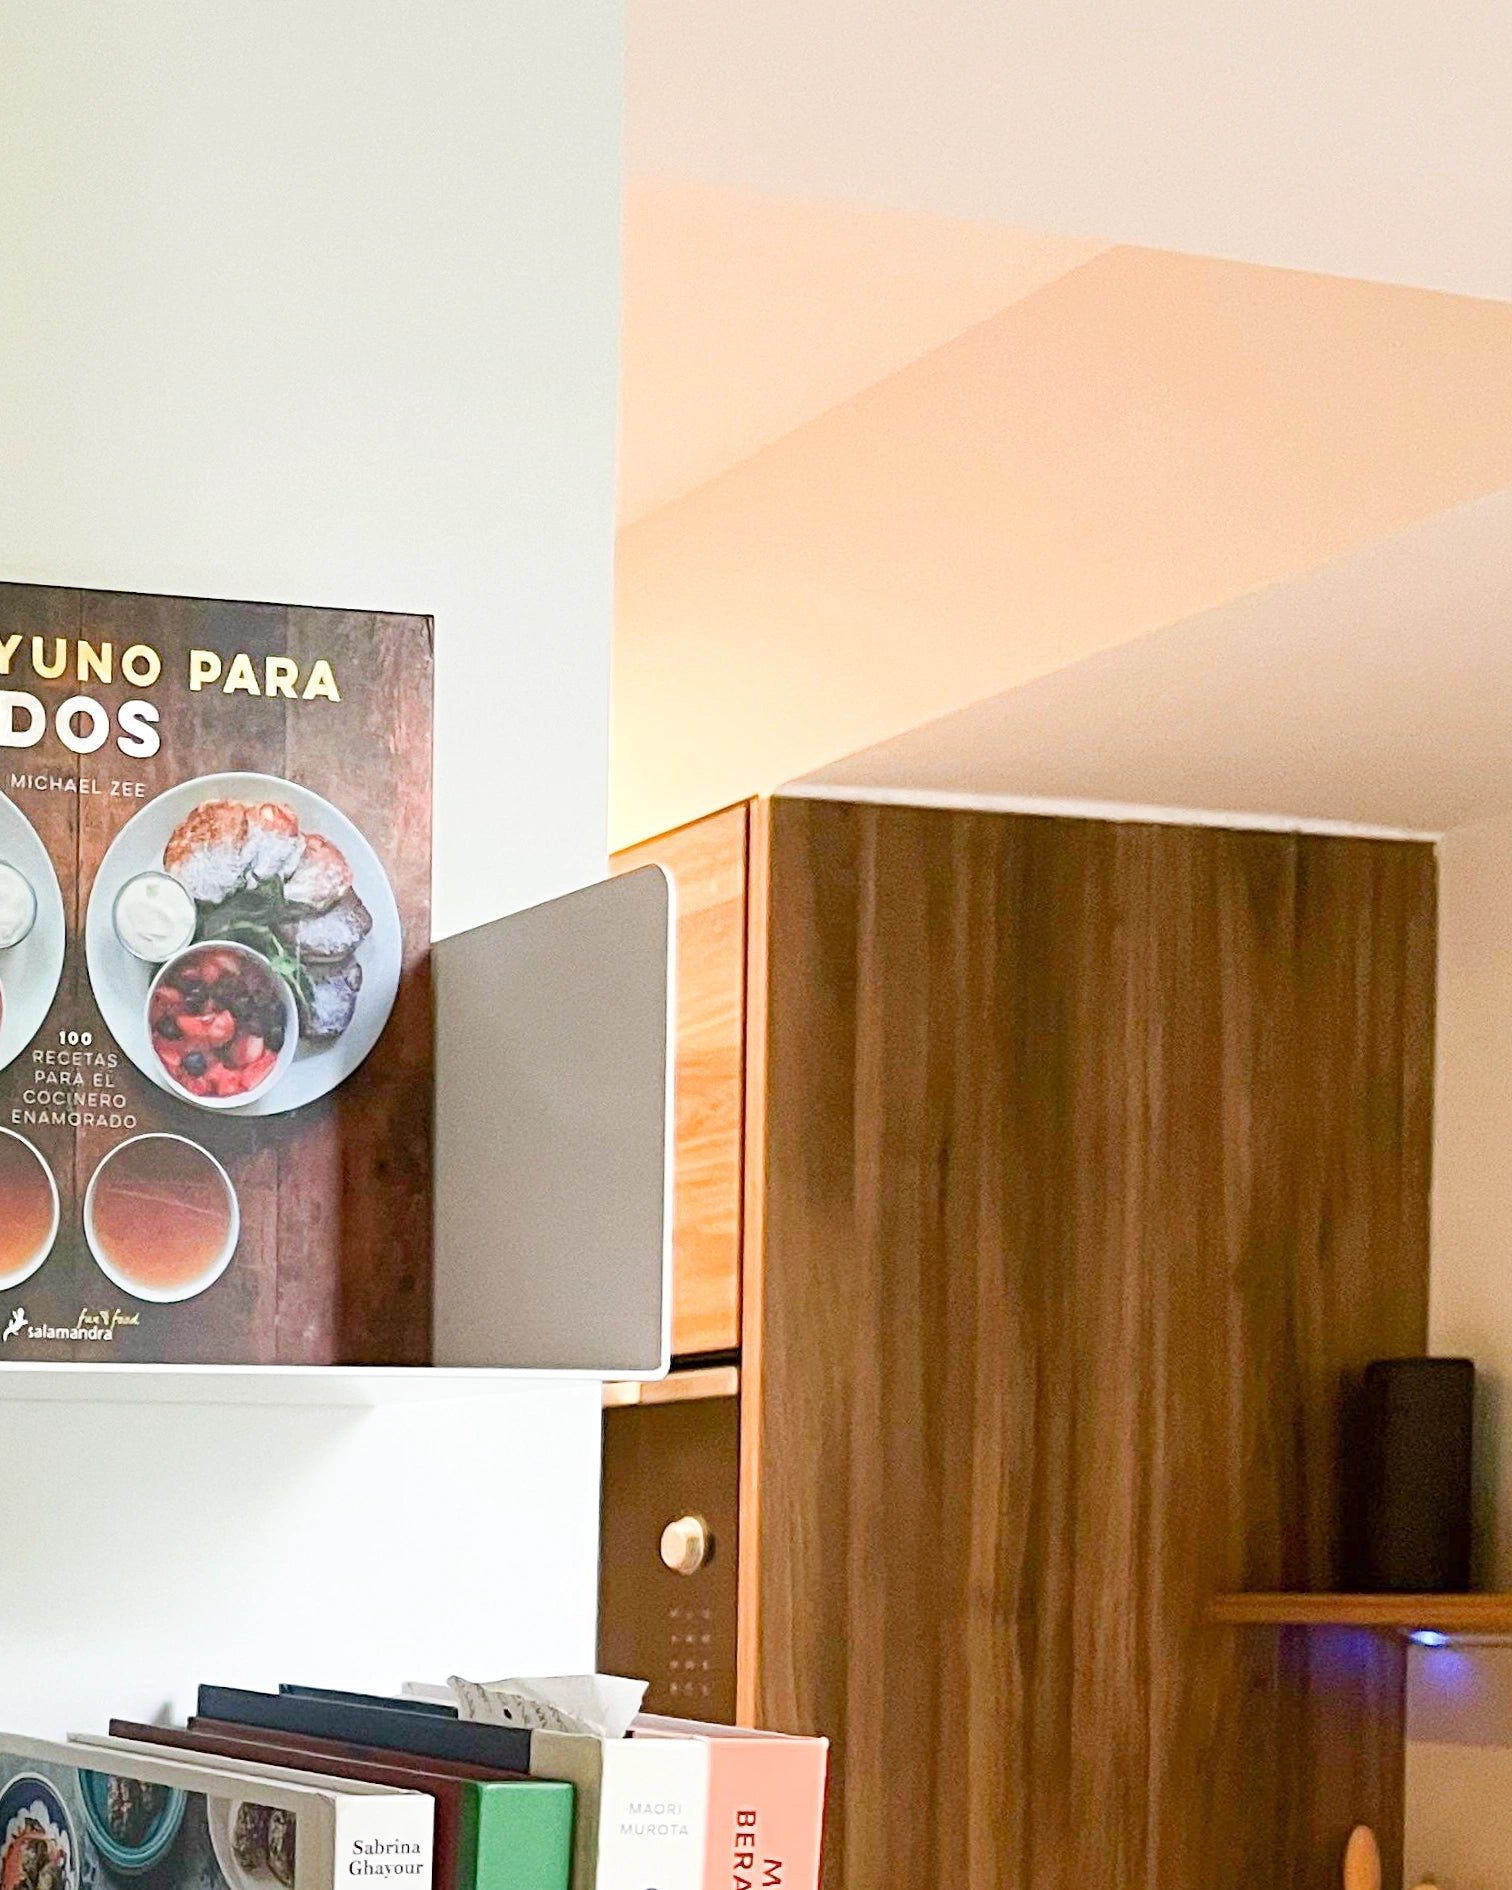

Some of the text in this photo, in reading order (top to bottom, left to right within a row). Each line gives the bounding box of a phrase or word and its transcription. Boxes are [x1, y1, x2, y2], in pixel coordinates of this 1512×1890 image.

[190, 650, 340, 701] PARA
[10, 773, 146, 798] MICHAEL ZEE
[58, 1030, 92, 1046] 100
[33, 1050, 118, 1069] RECETAS
[35, 1070, 115, 1088] PARA EL
[23, 1089, 127, 1110] COCINERO
[11, 1109, 137, 1129] ENAMORADO
[27, 1323, 113, 1341] salamandra
[629, 1803, 682, 1816] MAORI
[620, 1823, 689, 1837] MUROTA
[352, 1839, 421, 1856] Sabrina
[349, 1859, 424, 1878] Ghayour
